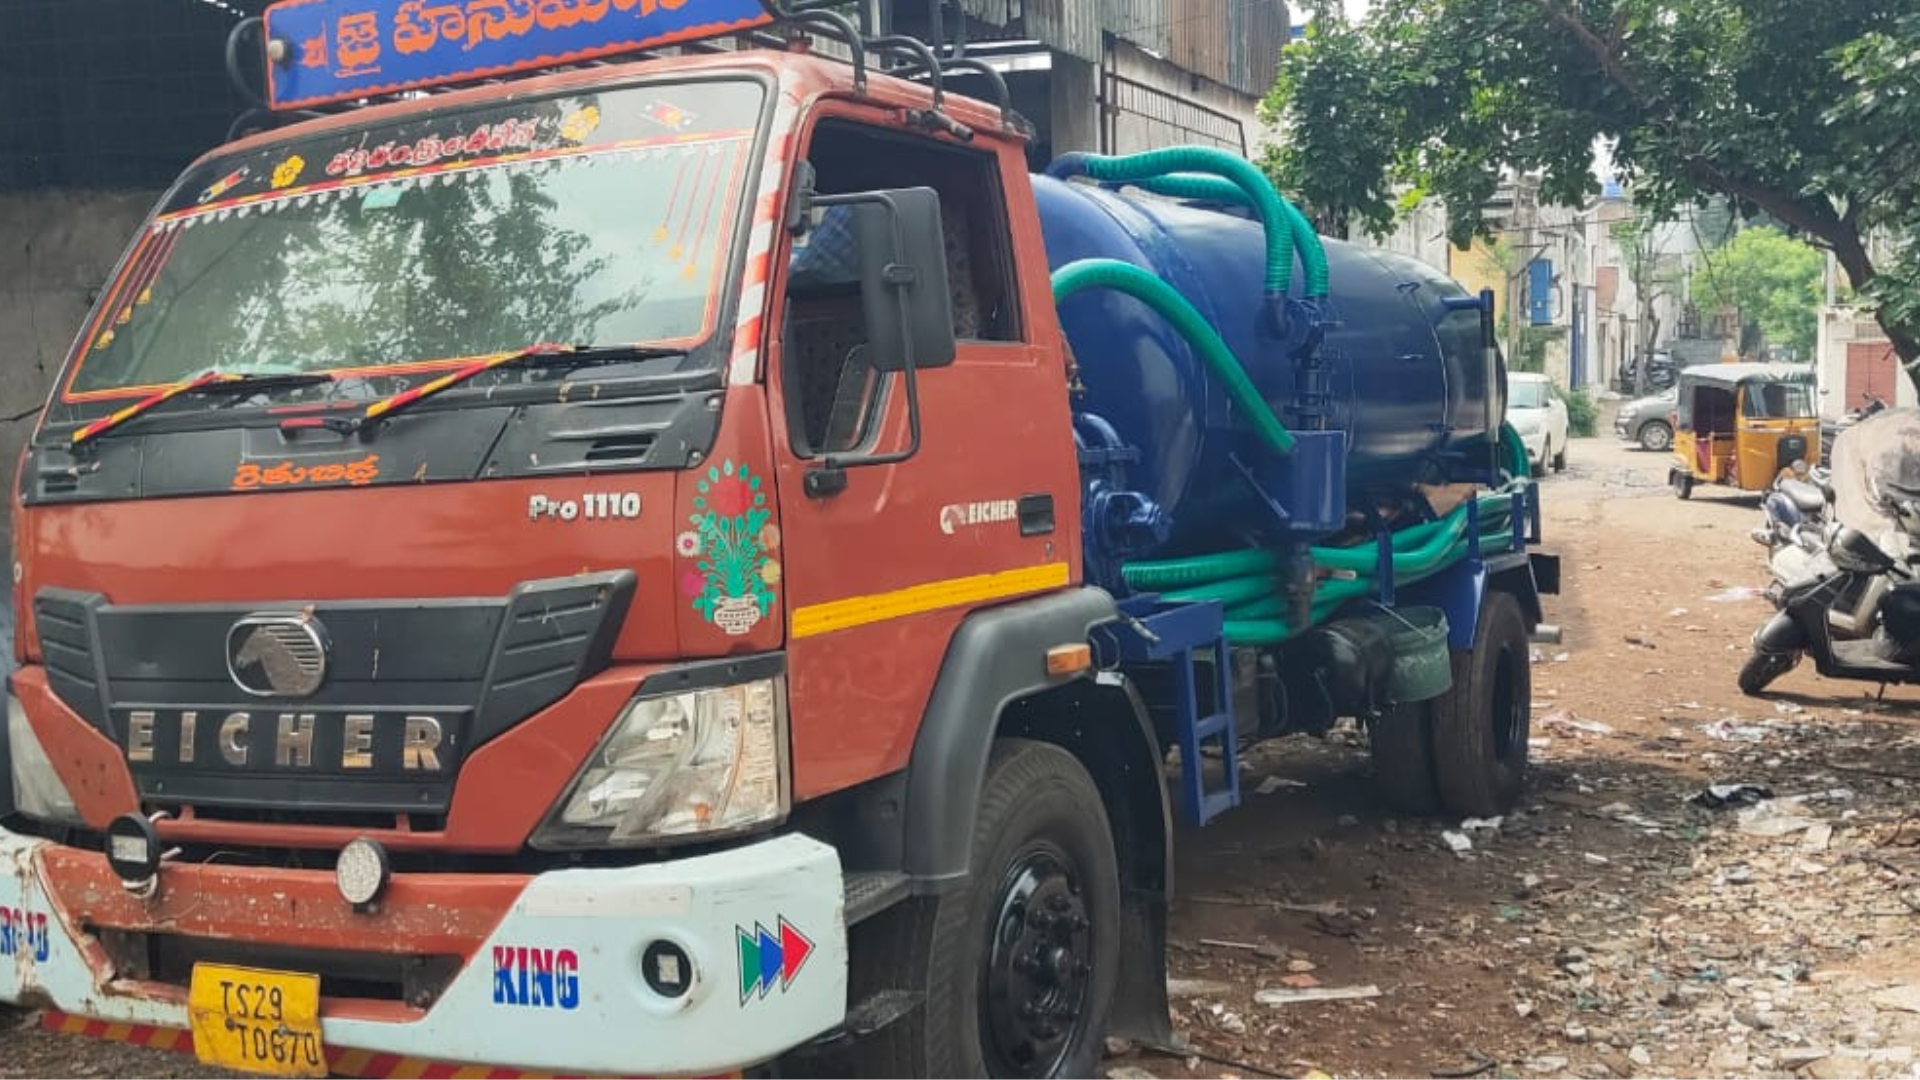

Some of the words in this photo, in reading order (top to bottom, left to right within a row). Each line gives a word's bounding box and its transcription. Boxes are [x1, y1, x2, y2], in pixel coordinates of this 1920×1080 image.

[529, 493, 579, 521] Pro
[583, 491, 641, 518] 1110
[968, 499, 1018, 525] EICHER
[128, 710, 444, 770] EICHER
[492, 945, 580, 1011] KING
[219, 981, 283, 1021] TS29
